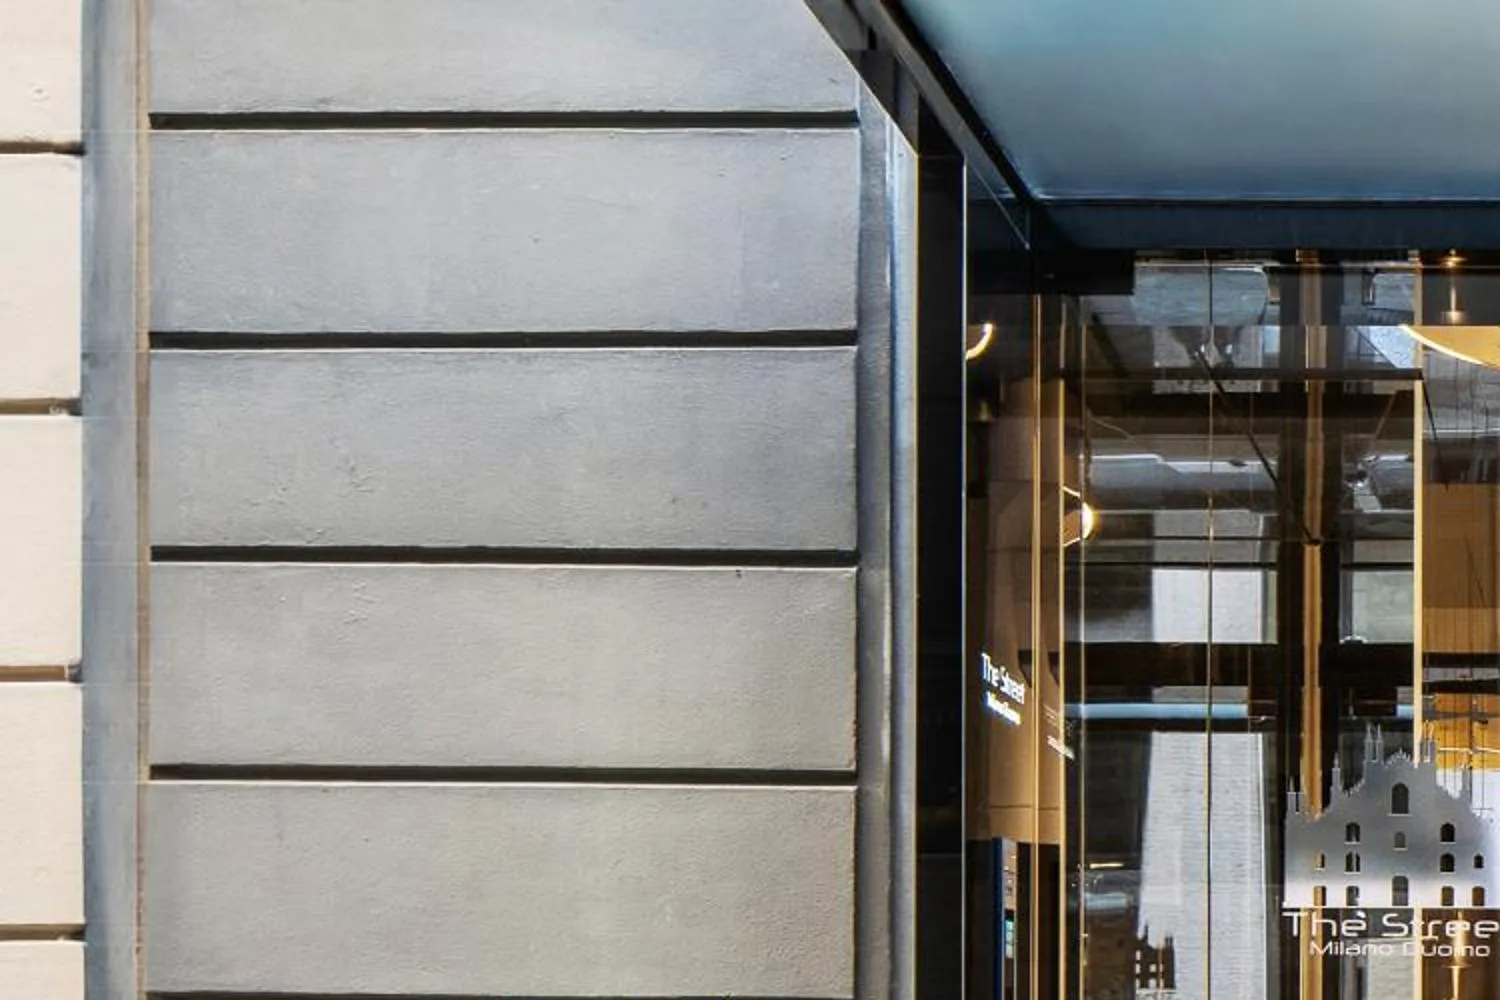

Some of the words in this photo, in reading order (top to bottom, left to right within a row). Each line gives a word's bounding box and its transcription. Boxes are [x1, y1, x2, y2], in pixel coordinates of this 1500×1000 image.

[1281, 911, 1367, 937] The
[1310, 940, 1394, 957] Milano
[1403, 941, 1490, 957] Duomo
